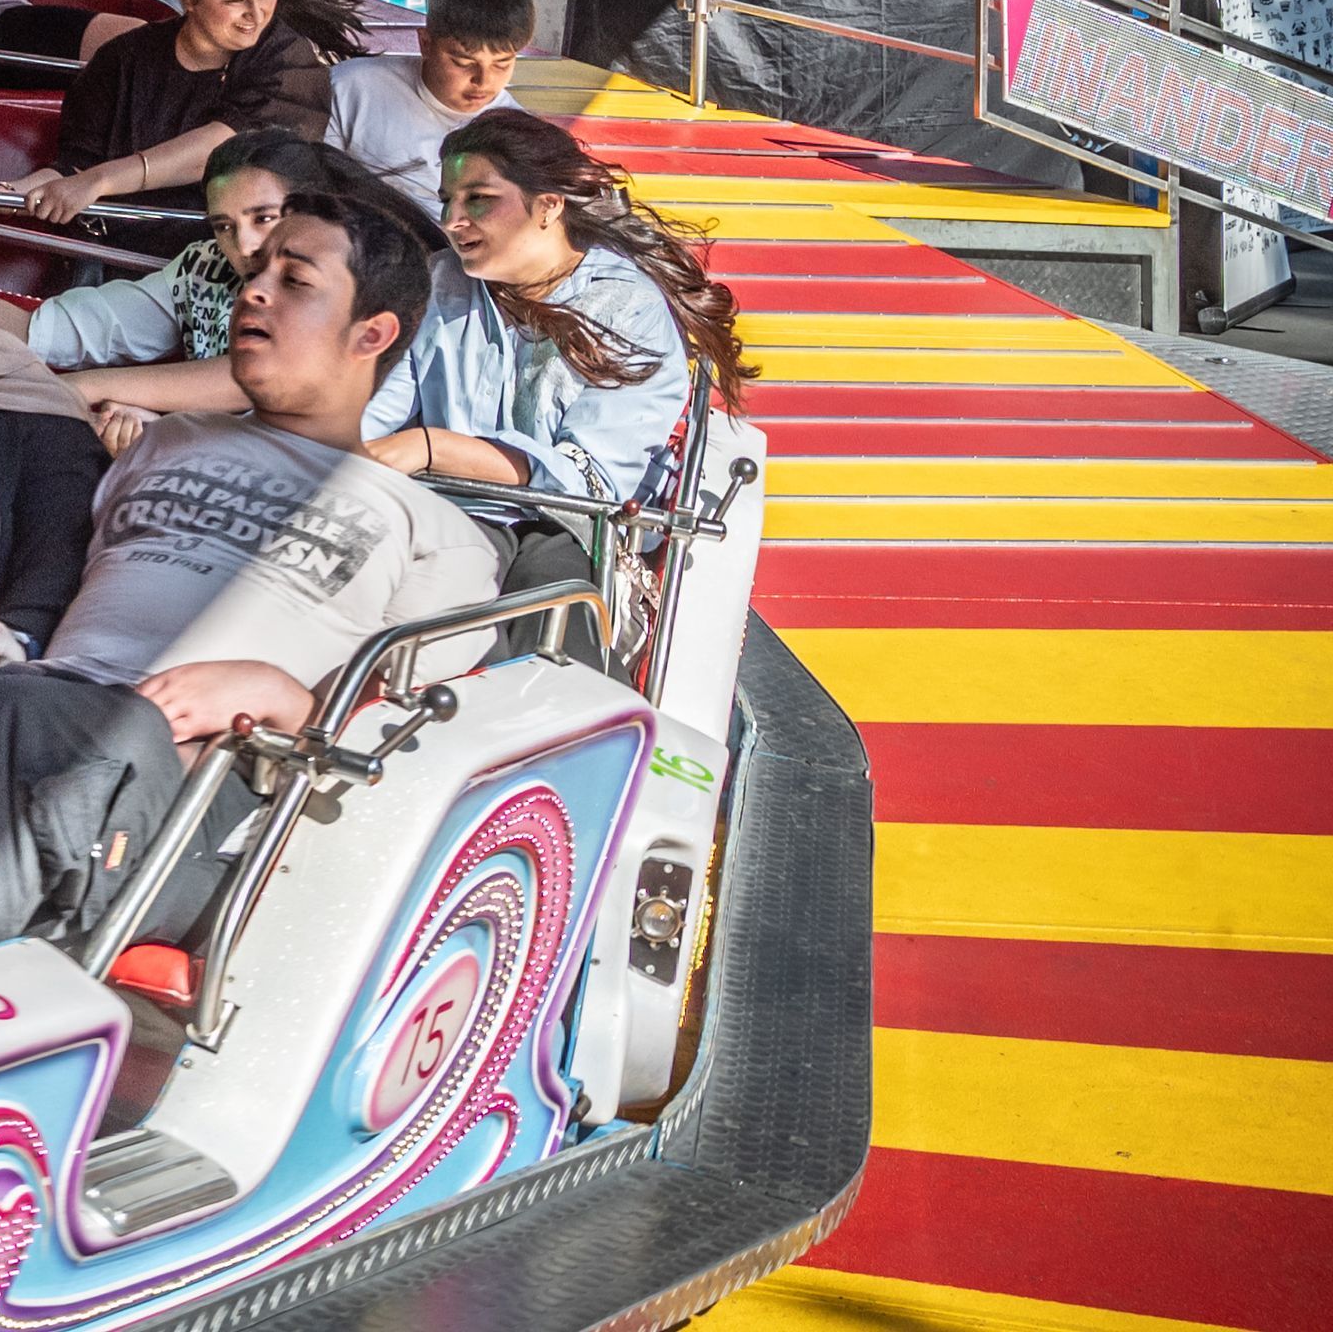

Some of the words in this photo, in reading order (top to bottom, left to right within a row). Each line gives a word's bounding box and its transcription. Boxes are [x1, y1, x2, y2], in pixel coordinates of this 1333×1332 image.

[130, 474, 209, 499] JEAN
[204, 487, 347, 543] PASCALE
[169, 458, 264, 490] ACK
[111, 498, 227, 534] CRSNG
[222, 516, 347, 580] DVSN
[649, 747, 714, 793] 16
[401, 999, 454, 1087] 15
